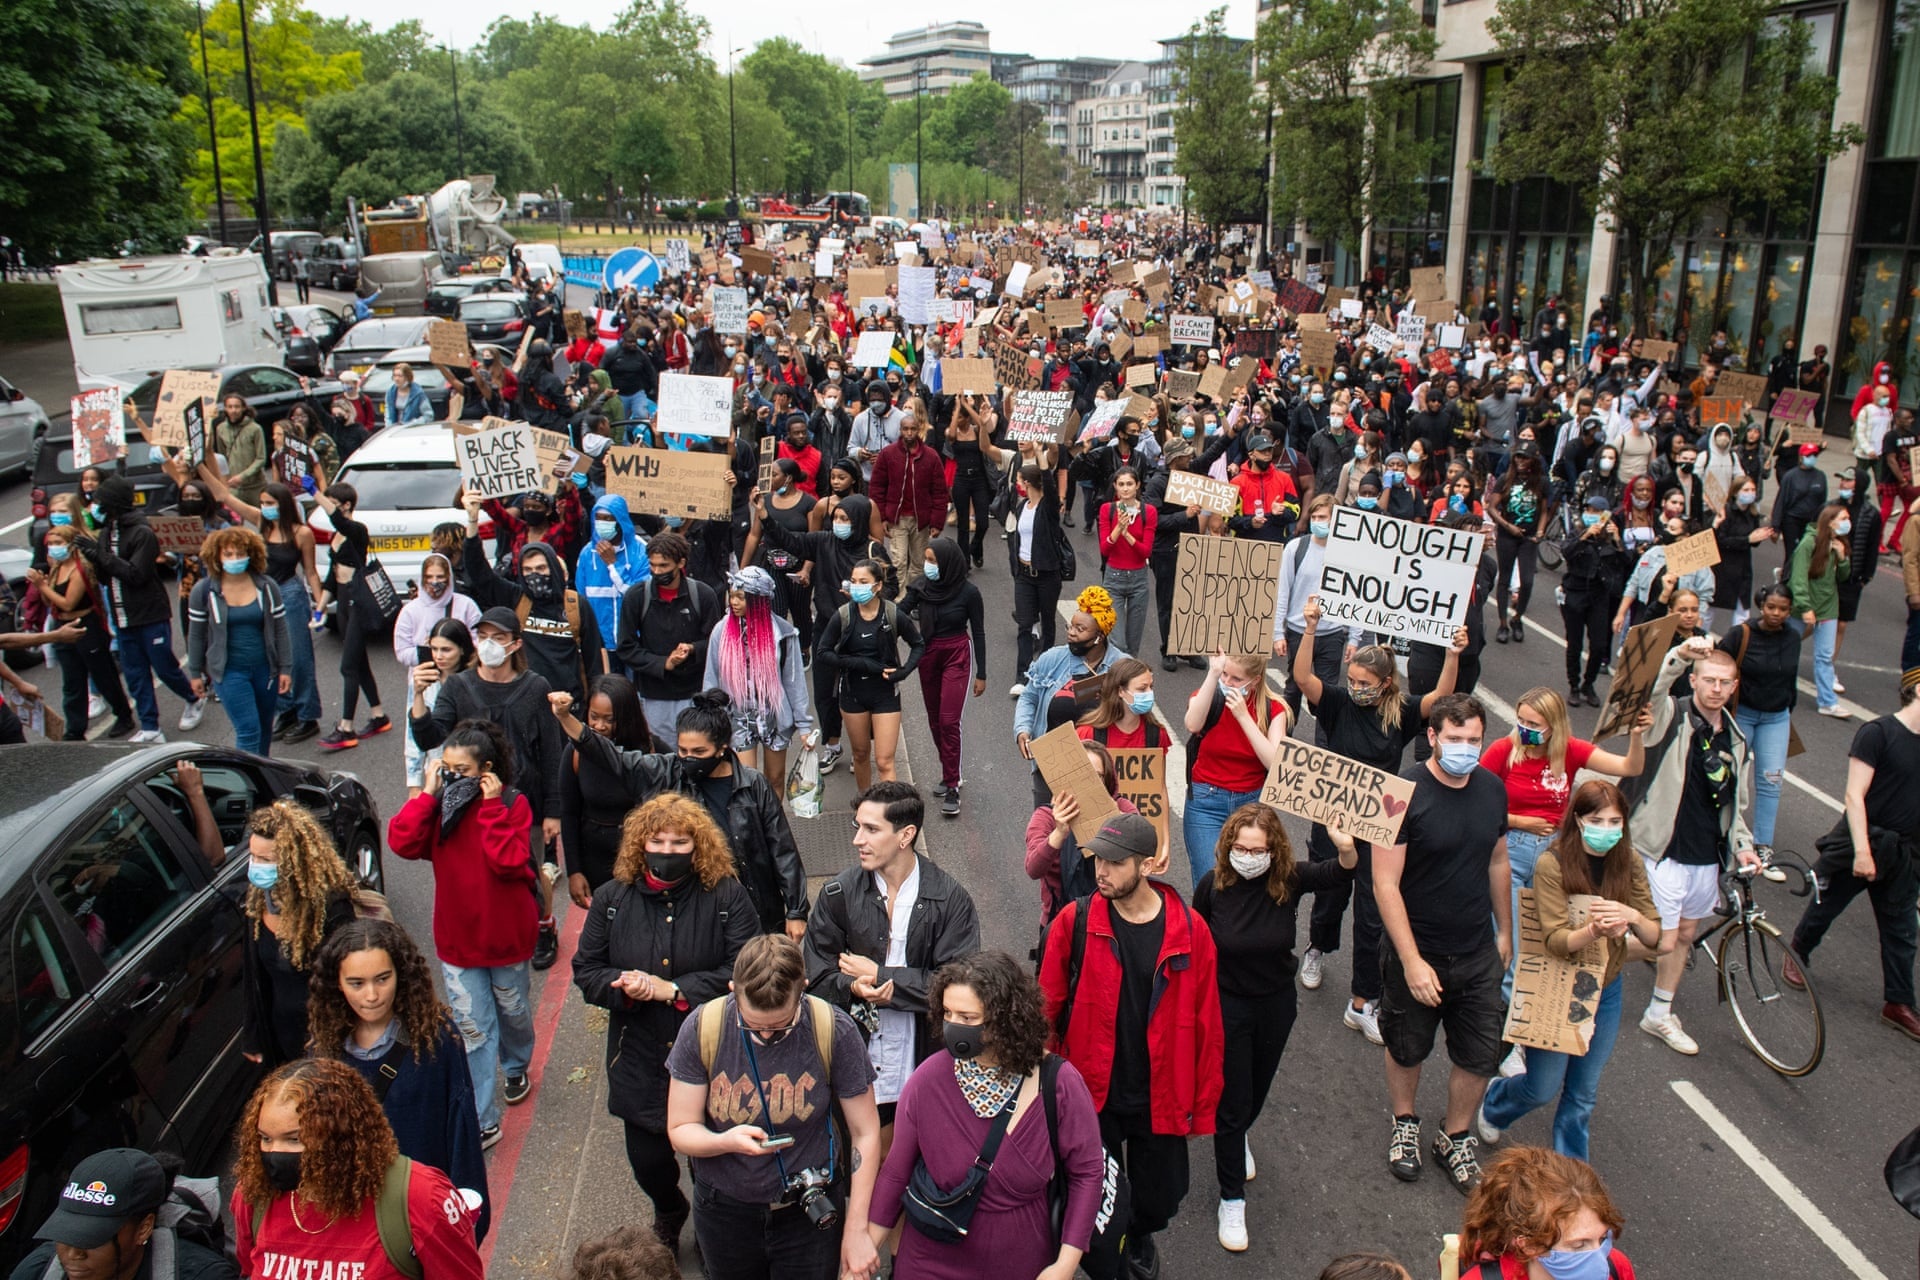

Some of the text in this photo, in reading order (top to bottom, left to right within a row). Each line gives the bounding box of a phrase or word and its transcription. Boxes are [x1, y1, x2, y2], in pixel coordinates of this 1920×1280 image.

[1000, 246, 1038, 261] BLACK
[1173, 328, 1210, 337] BREATHE
[1174, 319, 1210, 329] WE CAN'T
[1400, 316, 1424, 325] BLACK
[1397, 334, 1422, 342] MATTER
[999, 358, 1034, 380] MANY
[1001, 347, 1027, 366] HOW
[1017, 391, 1067, 400] IF VIOLENCE
[1720, 374, 1762, 391] BLACK
[1014, 406, 1065, 417] WHY DO THE
[1702, 399, 1742, 423] BLM
[1772, 391, 1819, 421] BLM
[1008, 421, 1049, 433] KILLING
[1011, 413, 1064, 427] POLICE KEEP
[465, 431, 525, 459] BLACK
[1007, 431, 1057, 443] EVERYONE
[472, 451, 520, 477] LIVES
[611, 454, 660, 478] WHY
[469, 468, 538, 496] MATTER
[1170, 472, 1237, 499] BLACK LIVES
[1167, 485, 1232, 513] MATTER
[152, 521, 200, 534] USTICE
[1333, 509, 1474, 564] ENOUGH
[1181, 537, 1282, 580] SILENCE
[1393, 556, 1423, 580] IS
[1178, 574, 1277, 617] SUPPORTS
[1320, 565, 1459, 619] ENOUGH
[1318, 598, 1364, 622] BLACK
[1364, 609, 1408, 632] LIVES
[1175, 614, 1273, 655] VIOLENCE
[1114, 755, 1156, 781] ACK
[1279, 741, 1386, 796] TOGETHER
[1278, 764, 1382, 818] WE STAND
[1265, 786, 1312, 817] BLACK
[1348, 816, 1394, 847] MATTER
[1508, 896, 1544, 1041] REST IN PEACE
[1095, 1155, 1120, 1236] Action
[262, 1252, 365, 1280] VINTAGE
